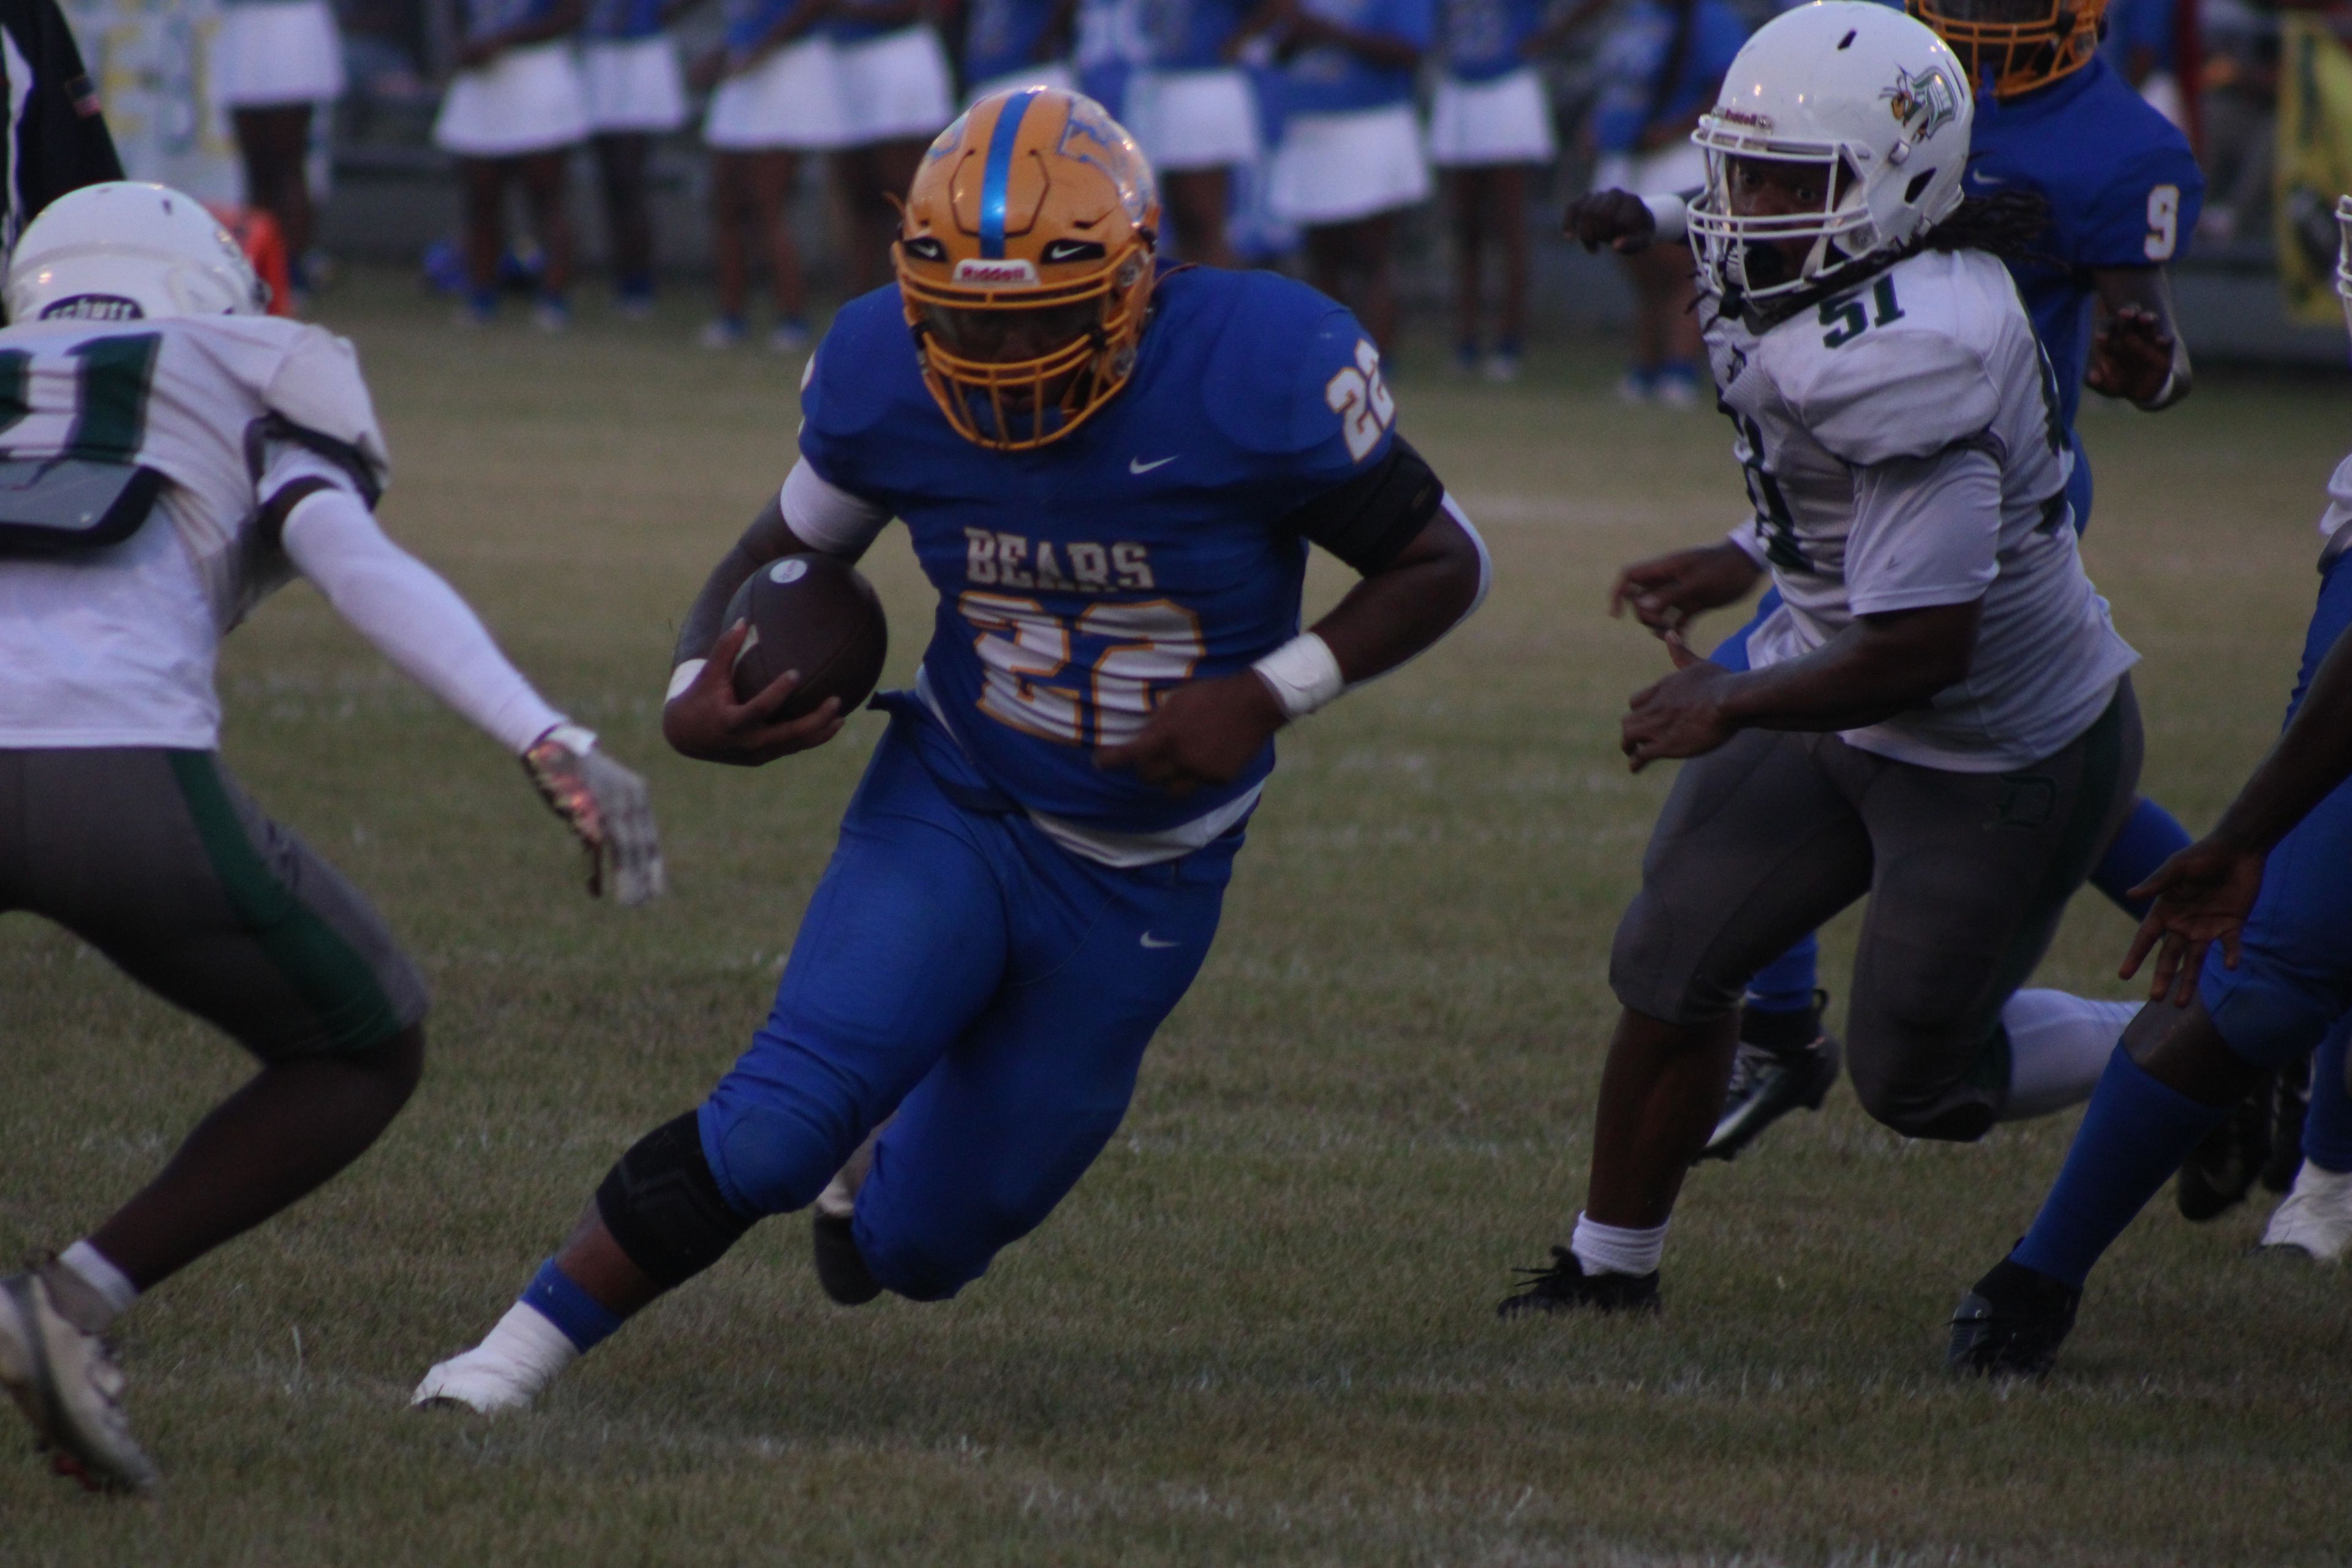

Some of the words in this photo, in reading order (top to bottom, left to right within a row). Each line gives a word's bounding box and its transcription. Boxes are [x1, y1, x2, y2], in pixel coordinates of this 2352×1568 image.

[2144, 184, 2180, 261] 9
[962, 266, 1025, 282] Riddell
[1819, 273, 1906, 349] 51
[0, 331, 163, 464] 1
[1325, 339, 1398, 466] 22
[963, 527, 1155, 593] BEARS
[957, 590, 1206, 746] 22
